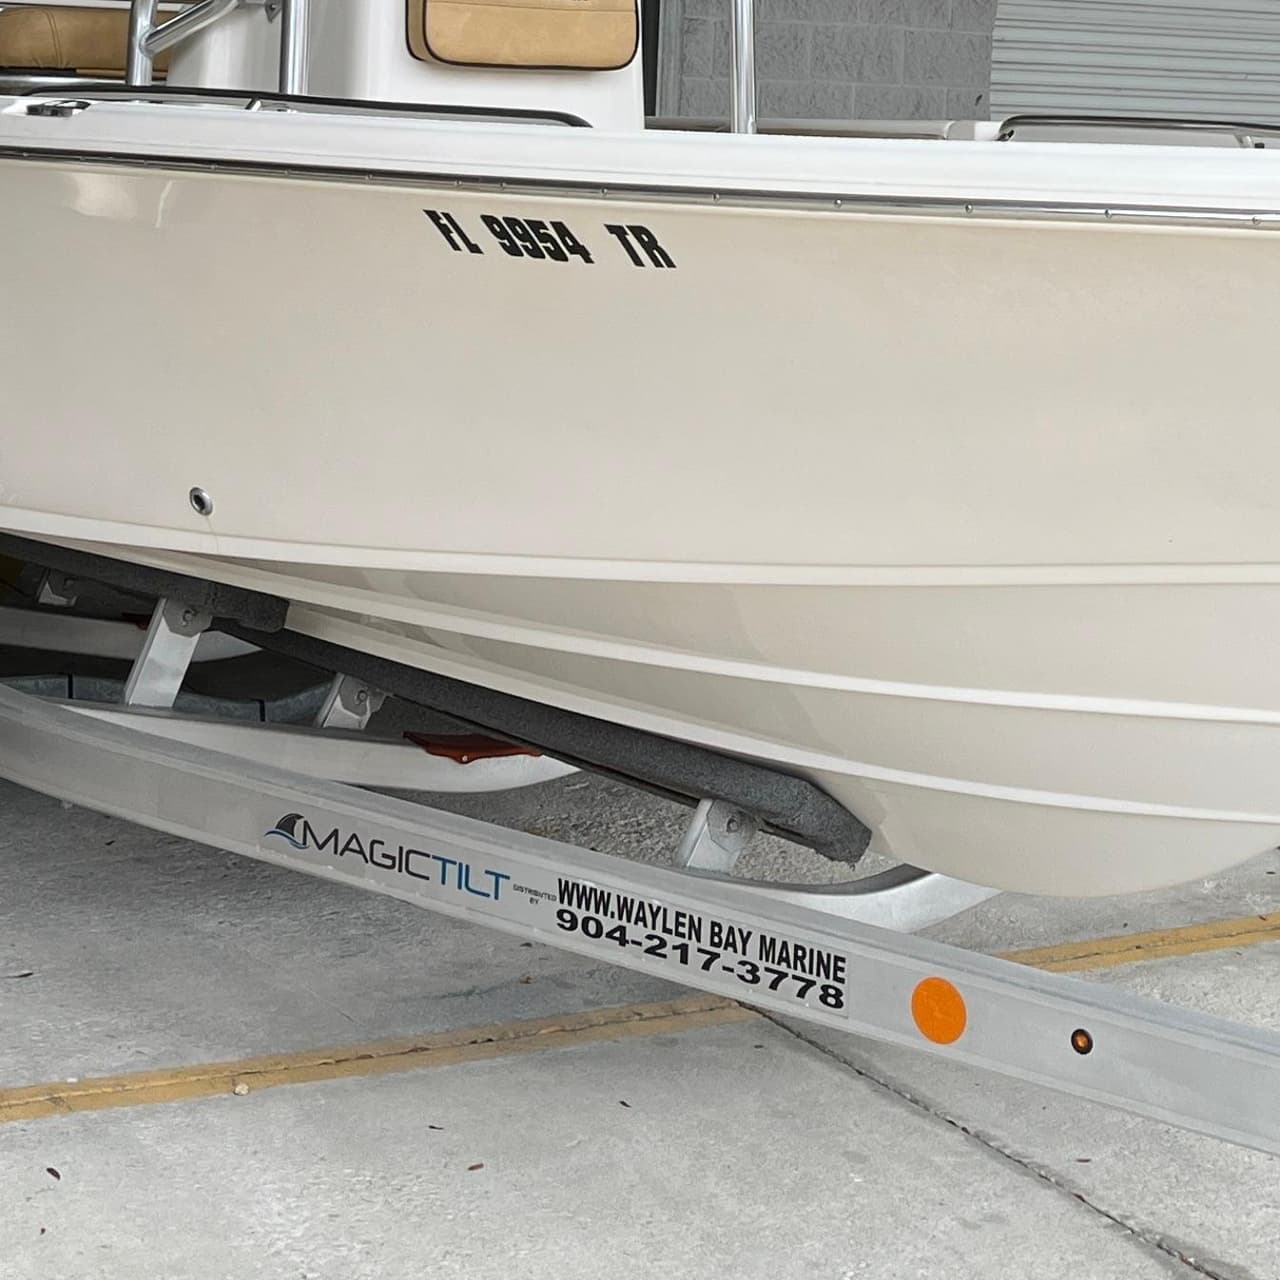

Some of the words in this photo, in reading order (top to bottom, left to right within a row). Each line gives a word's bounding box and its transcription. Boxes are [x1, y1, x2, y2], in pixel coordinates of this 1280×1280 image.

[422, 208, 484, 255] FL
[480, 214, 595, 264] 9954
[604, 223, 677, 269] TR
[301, 819, 510, 902] MAGICTILT
[554, 907, 846, 1011] 904-217-3778
[556, 877, 702, 944] WWW.WAYLEN
[708, 919, 752, 958] BAY
[758, 933, 847, 985] MARINE
